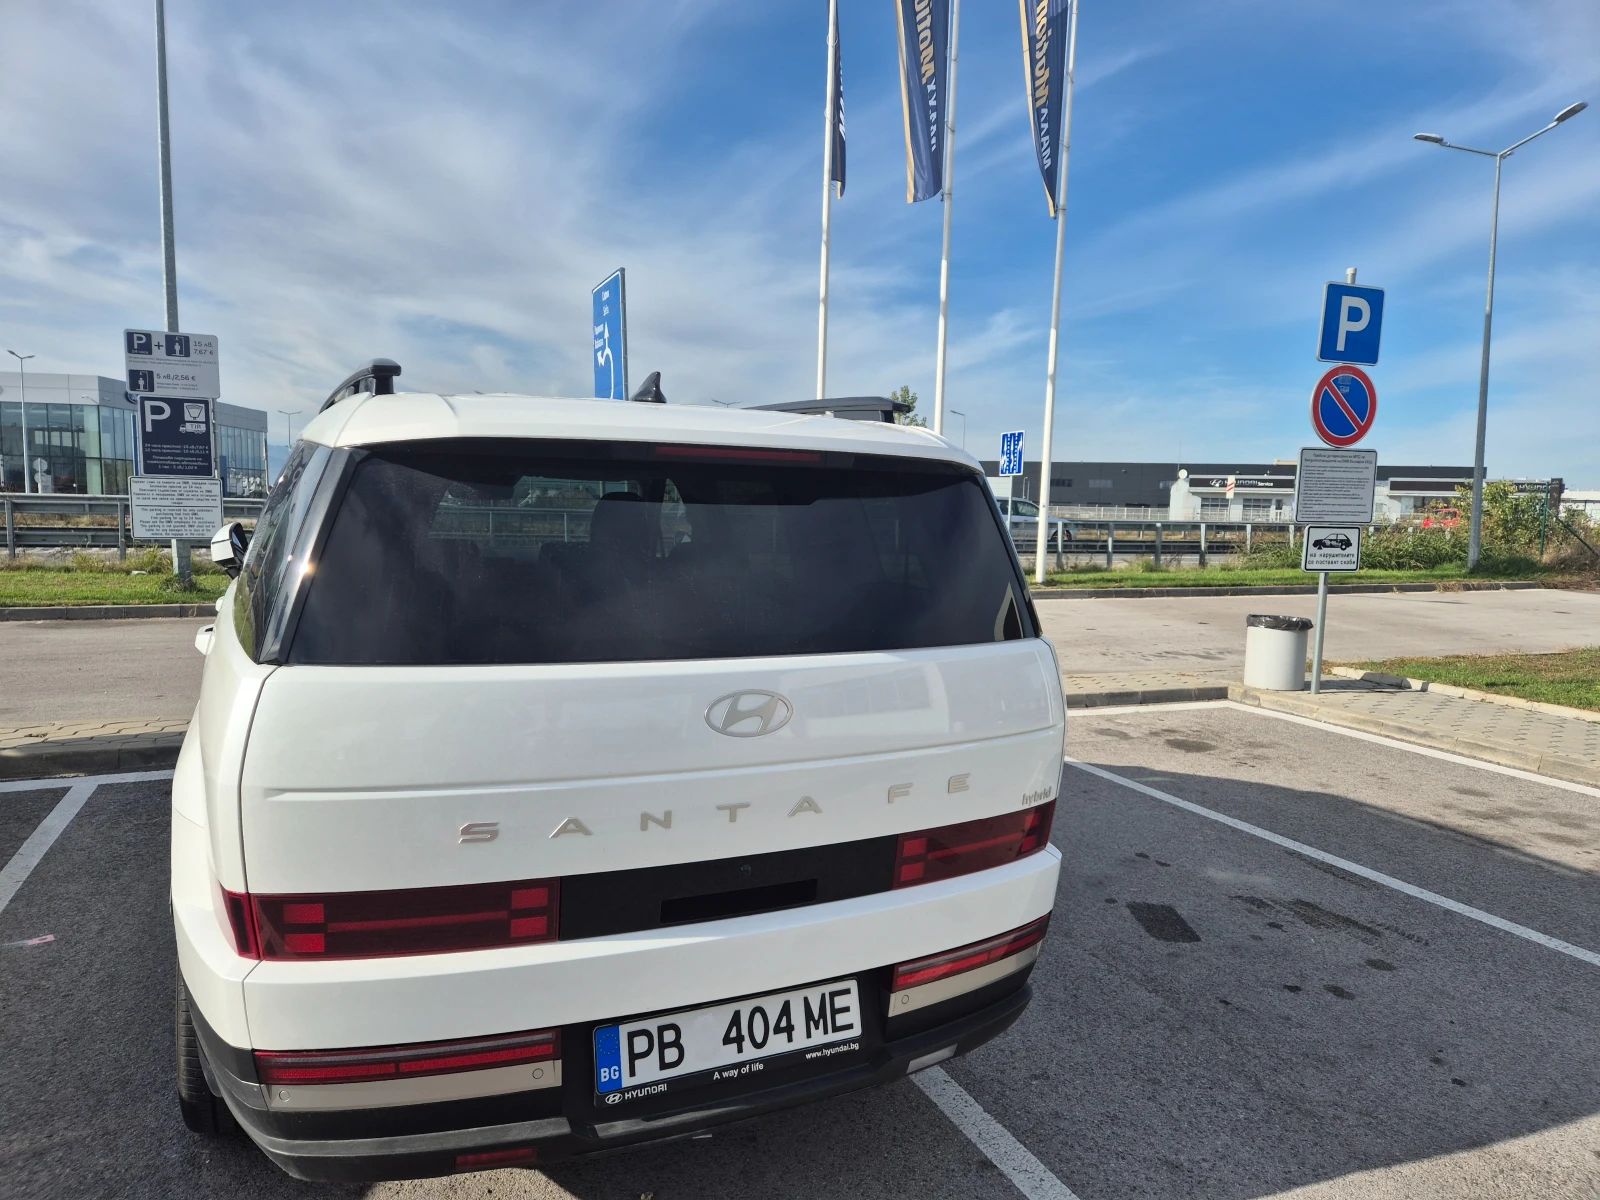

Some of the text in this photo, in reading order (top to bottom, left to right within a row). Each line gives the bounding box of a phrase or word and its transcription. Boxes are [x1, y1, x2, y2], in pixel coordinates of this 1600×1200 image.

[1336, 295, 1371, 351] P
[133, 334, 146, 349] P
[144, 400, 171, 432] P
[1021, 786, 1052, 807] hybrid
[458, 774, 972, 844] SANTA FE
[627, 1022, 685, 1078] PB
[805, 1042, 860, 1060] www.hyundai.bg
[600, 1065, 620, 1082] BG
[713, 1062, 764, 1081] A way of life
[624, 1083, 668, 1101] HYUNDAI
